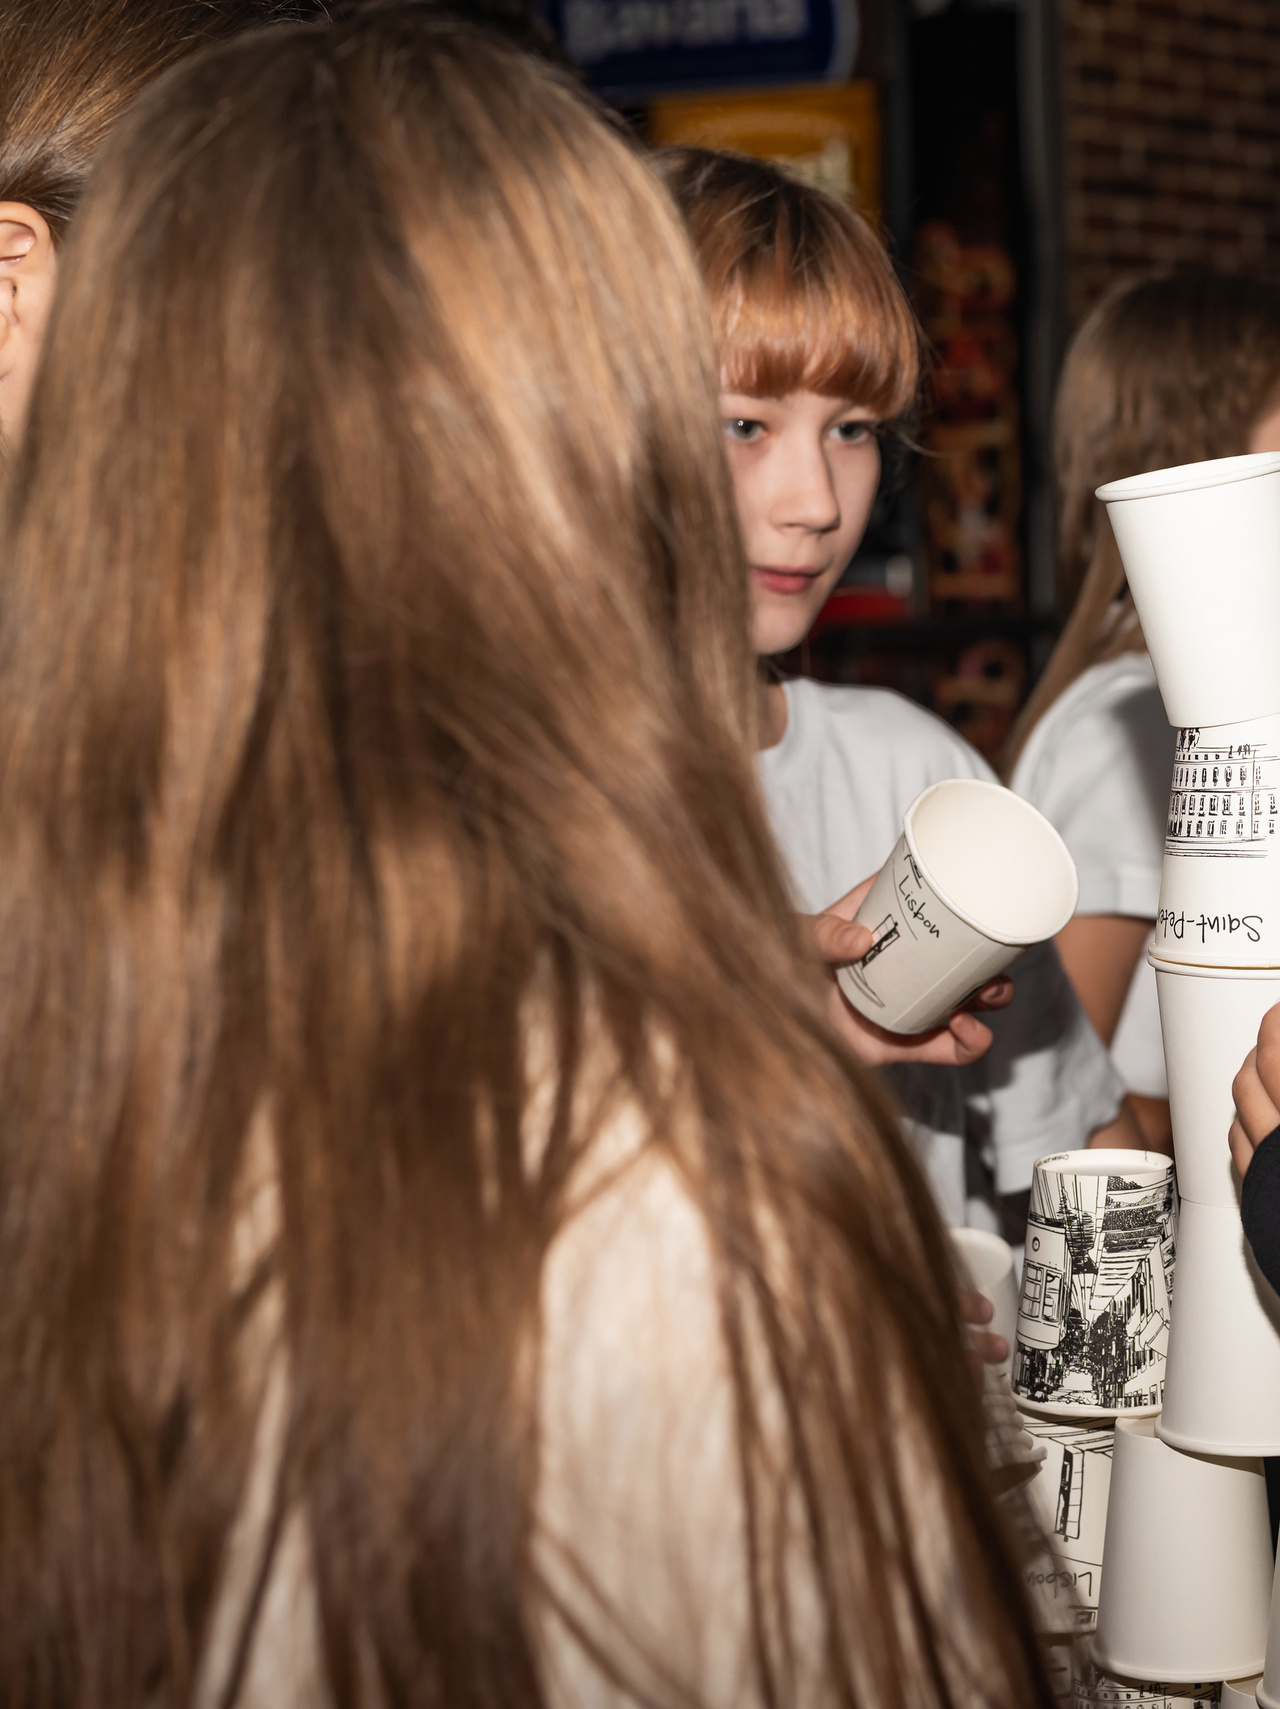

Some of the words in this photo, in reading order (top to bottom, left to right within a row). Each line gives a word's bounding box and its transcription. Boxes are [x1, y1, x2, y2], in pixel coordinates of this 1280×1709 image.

[898, 875, 940, 938] Lisbon
[1157, 909, 1263, 943] Saint-Pete
[1024, 1571, 1093, 1600] Lisbon
